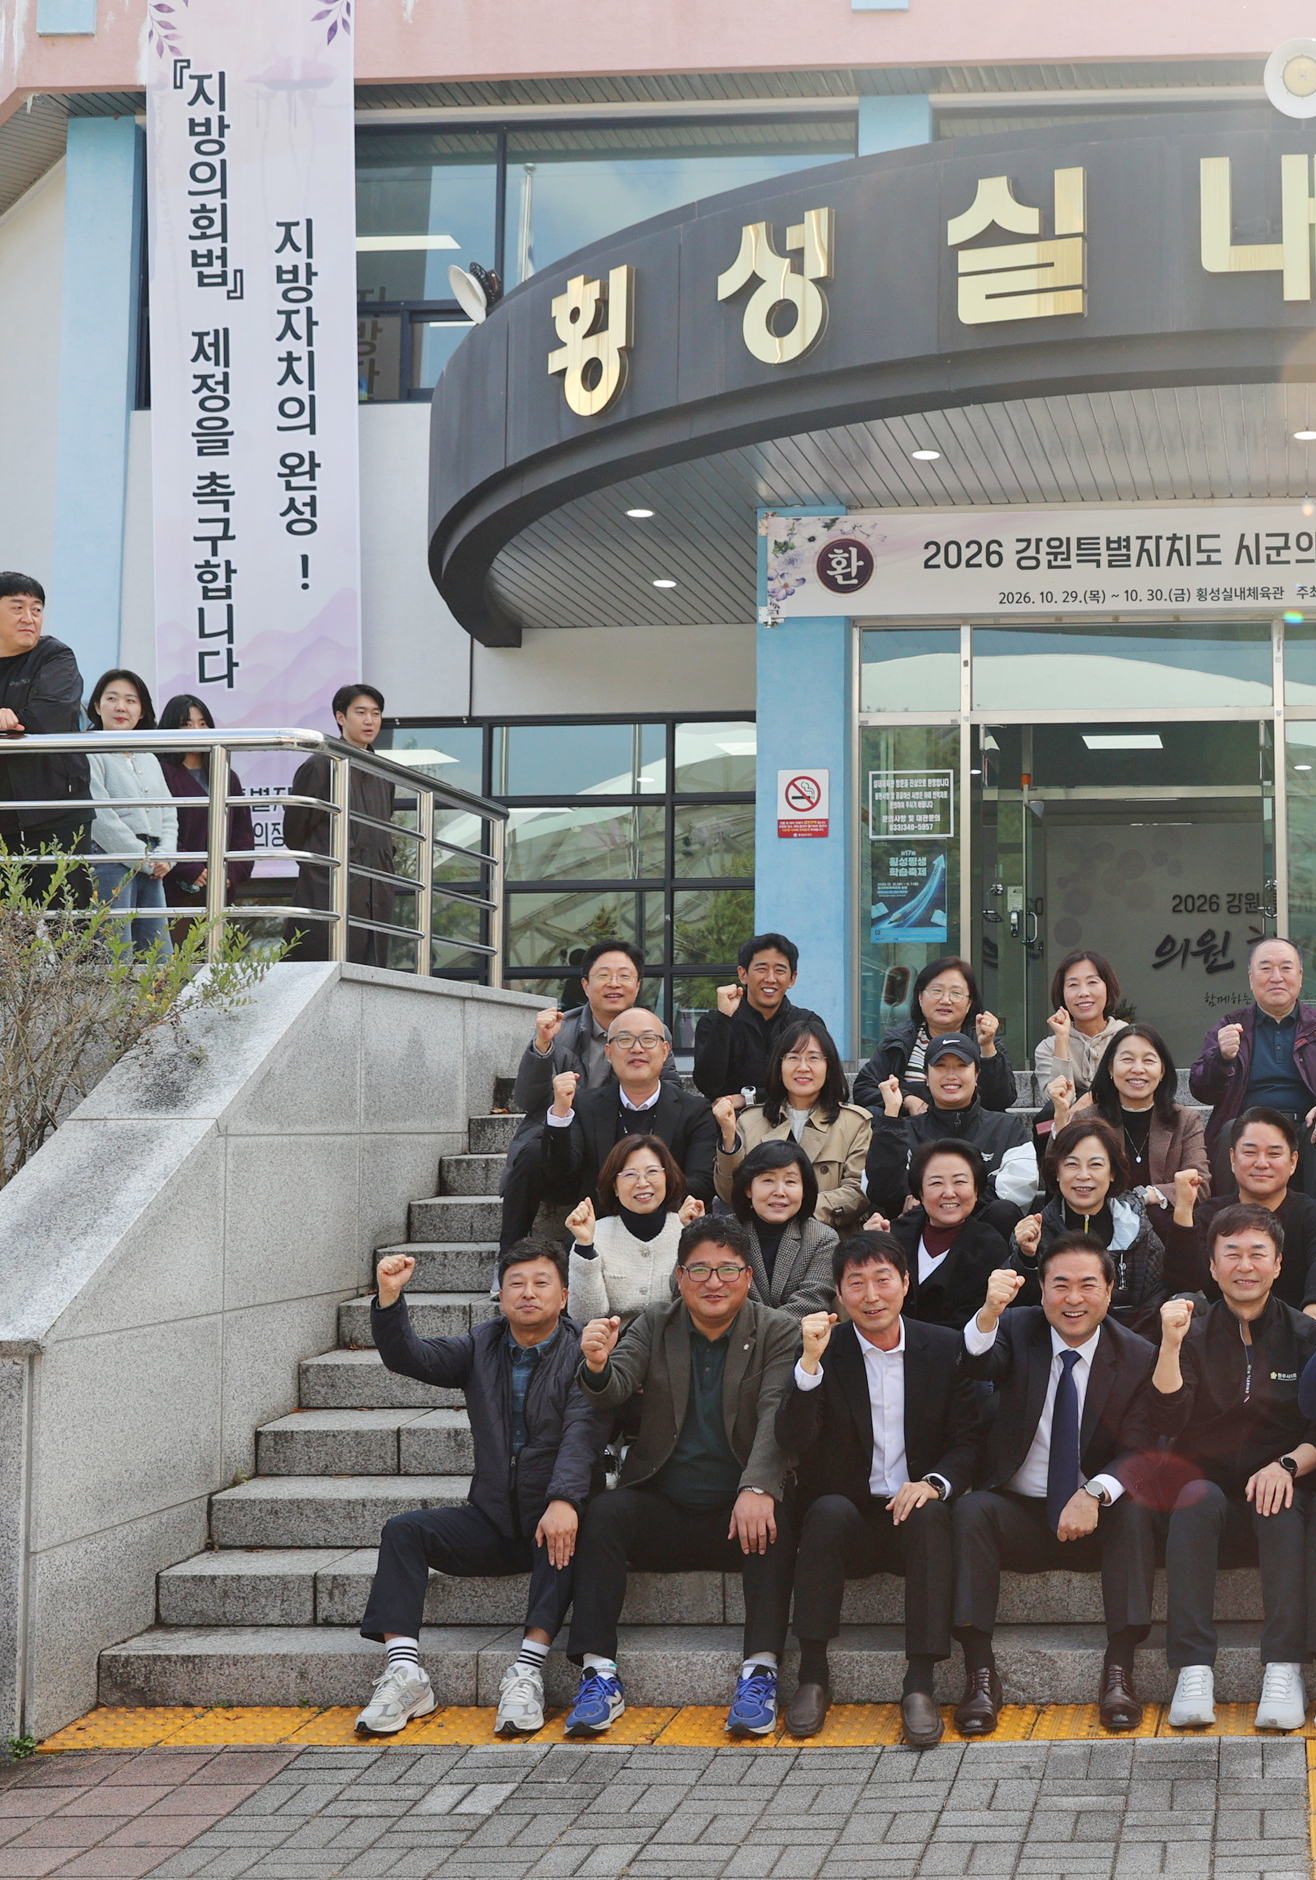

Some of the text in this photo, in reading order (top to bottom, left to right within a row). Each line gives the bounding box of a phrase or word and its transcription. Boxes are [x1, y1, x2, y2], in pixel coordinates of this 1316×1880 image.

[274, 218, 318, 436] 지방자치의
[191, 327, 234, 457] 제정을
[276, 449, 320, 536] 완성
[826, 547, 865, 585] 환
[923, 540, 1004, 569] 2026
[1016, 533, 1222, 571] 강원특별자치도
[192, 471, 240, 688] 촉구합니다
[1196, 586, 1285, 602] 횡성실내체육관
[1172, 895, 1220, 913] 2026
[1152, 928, 1234, 974] 의원
